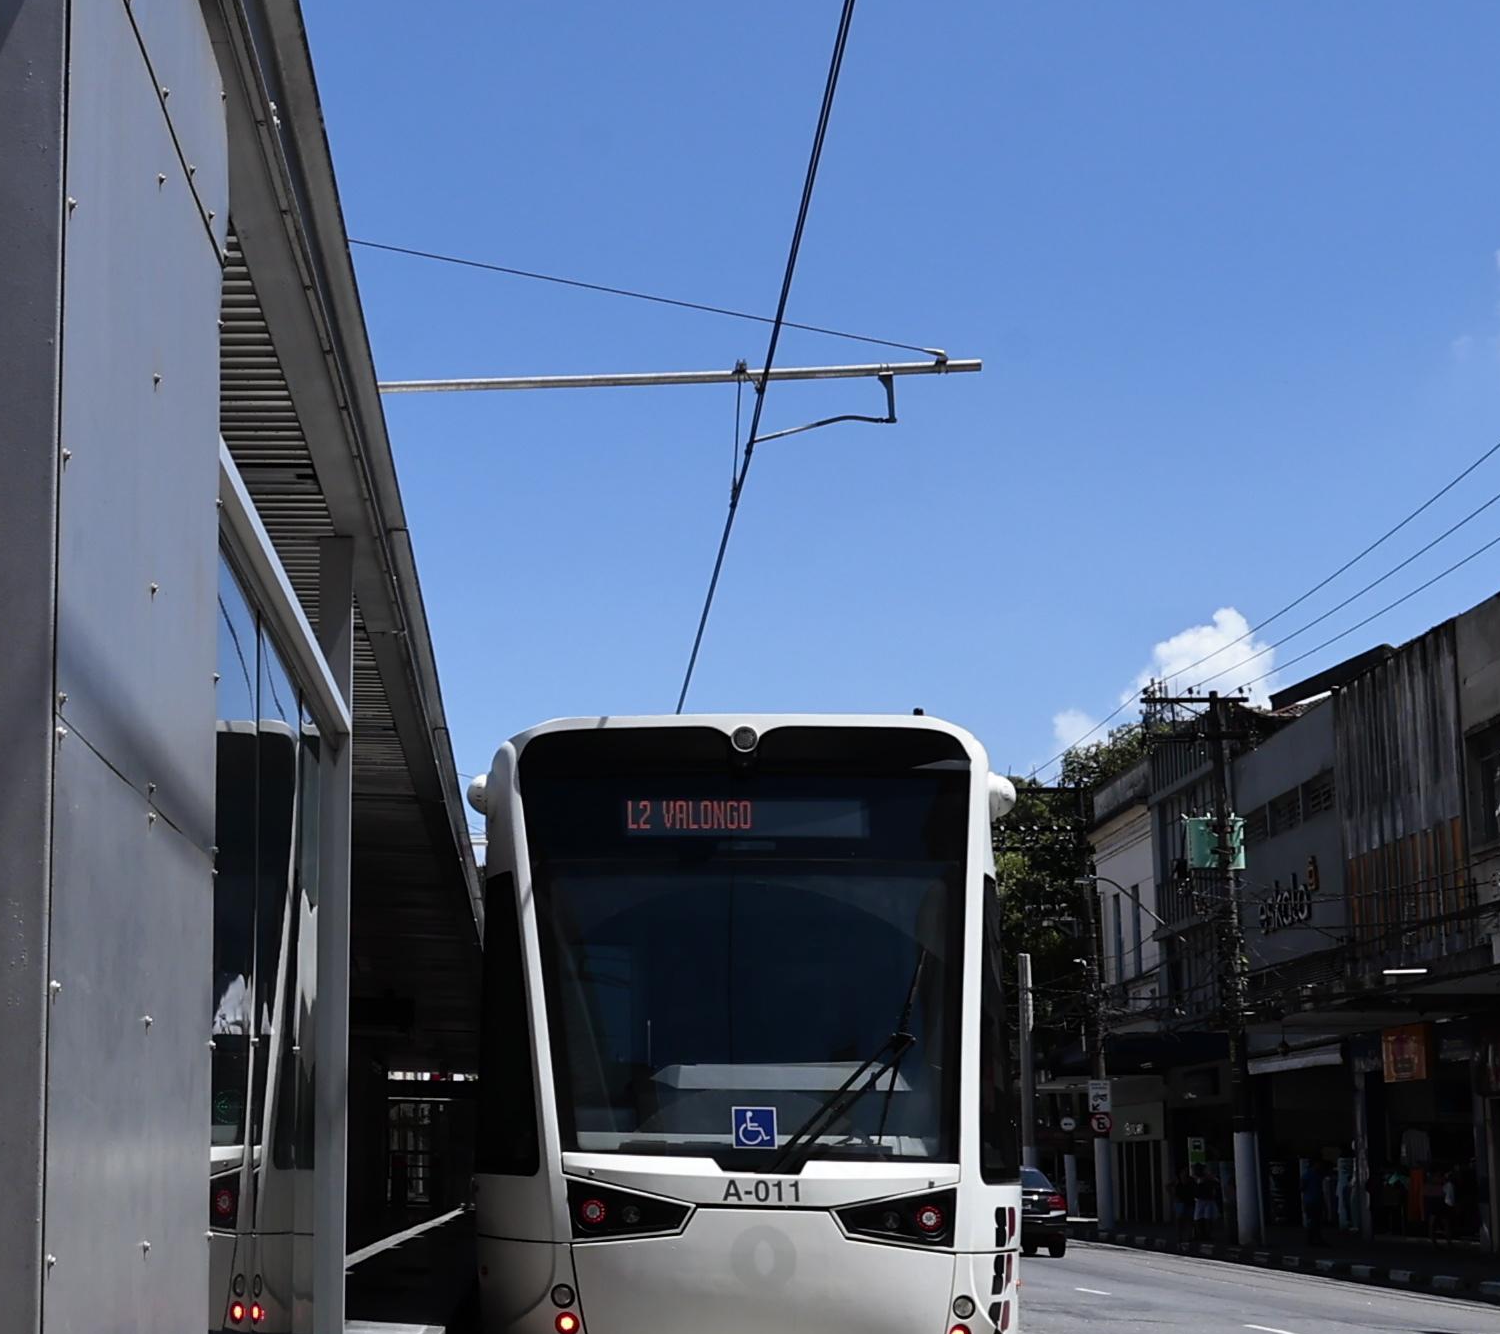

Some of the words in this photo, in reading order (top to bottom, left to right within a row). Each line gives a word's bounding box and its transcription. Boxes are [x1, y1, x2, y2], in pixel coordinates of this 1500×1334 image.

[626, 799, 651, 830] L2
[662, 799, 752, 830] VALONGO
[722, 1178, 800, 1203] A-011
